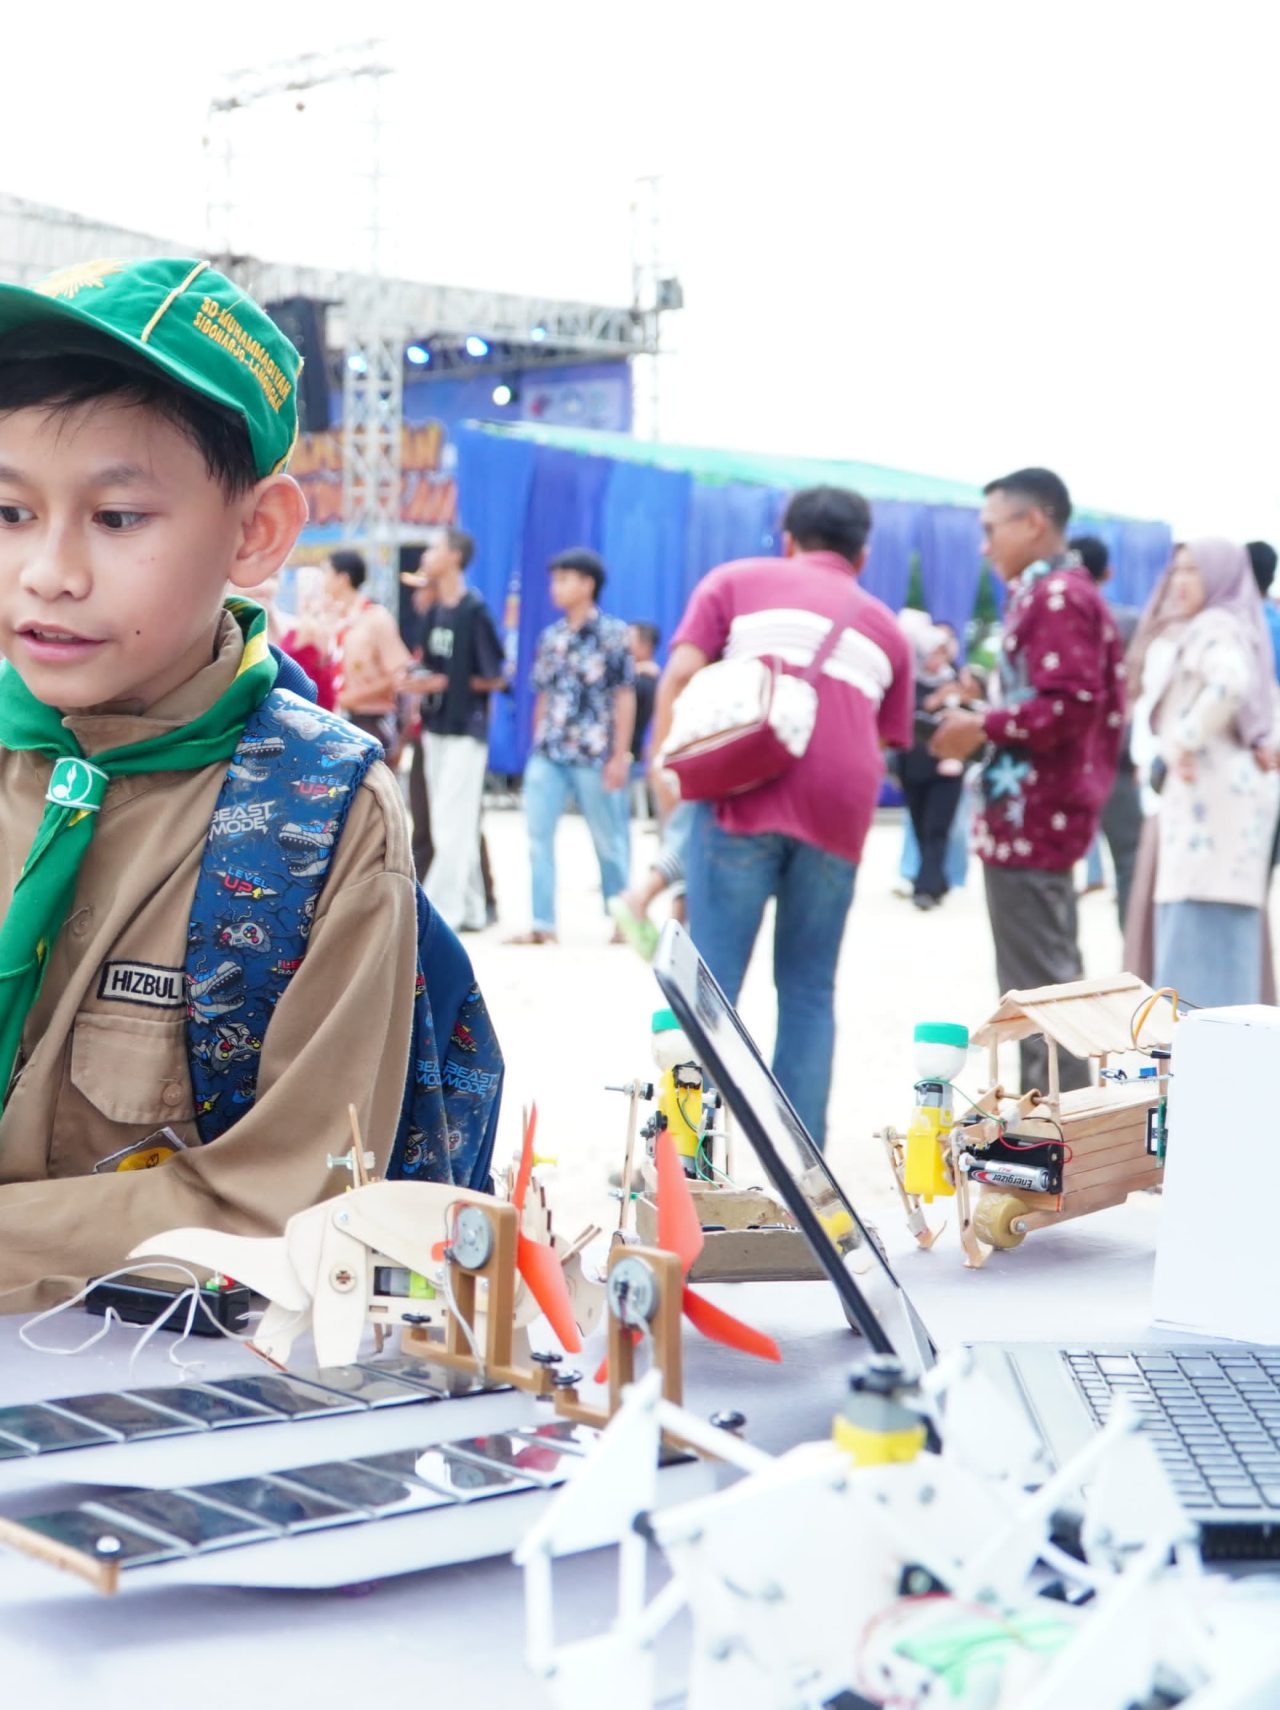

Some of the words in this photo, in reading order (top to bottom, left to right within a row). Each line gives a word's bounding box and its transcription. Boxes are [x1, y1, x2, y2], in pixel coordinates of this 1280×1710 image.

[299, 783, 328, 795] UP
[302, 774, 342, 786] LEVEL
[209, 817, 269, 842] MODE
[224, 875, 253, 893] UP
[228, 866, 269, 889] LEVEL
[111, 969, 179, 1000] HIZBUL
[992, 1174, 1033, 1189] Energizer
